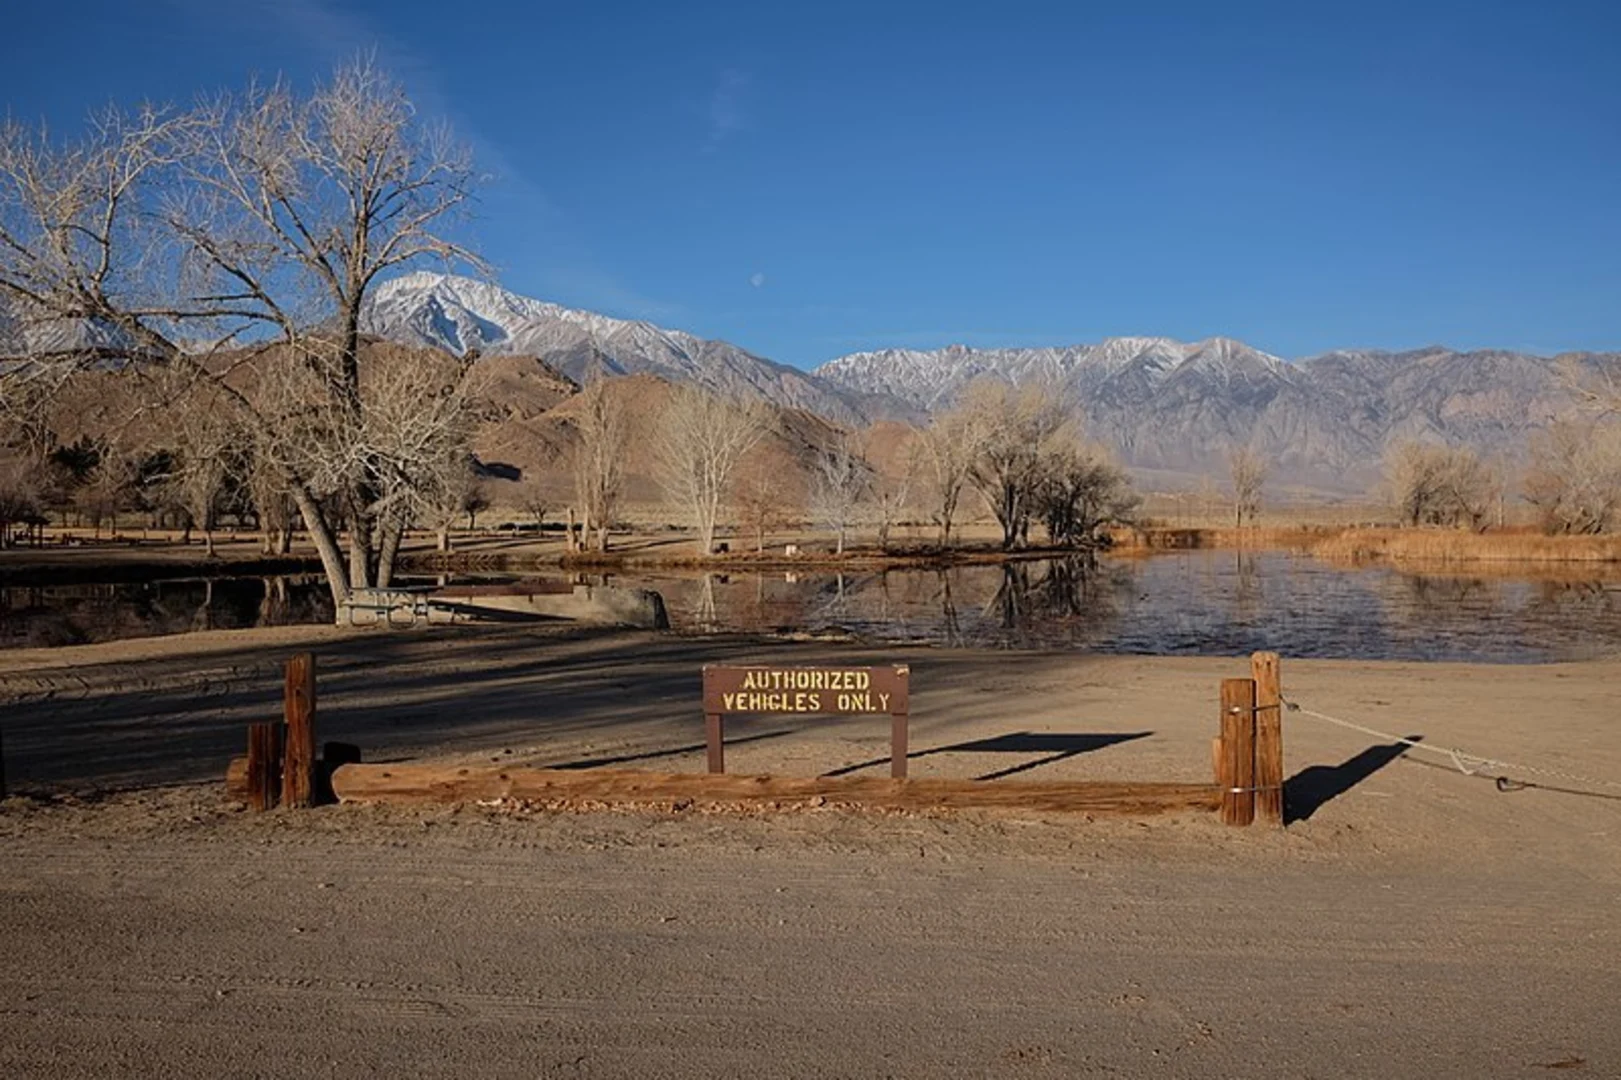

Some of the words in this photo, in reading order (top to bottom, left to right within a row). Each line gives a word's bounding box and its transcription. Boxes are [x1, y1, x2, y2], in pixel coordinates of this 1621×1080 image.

[743, 671, 870, 690] AUTHORIZED
[723, 693, 821, 711] VEHICLES
[837, 692, 890, 711] ONLY
